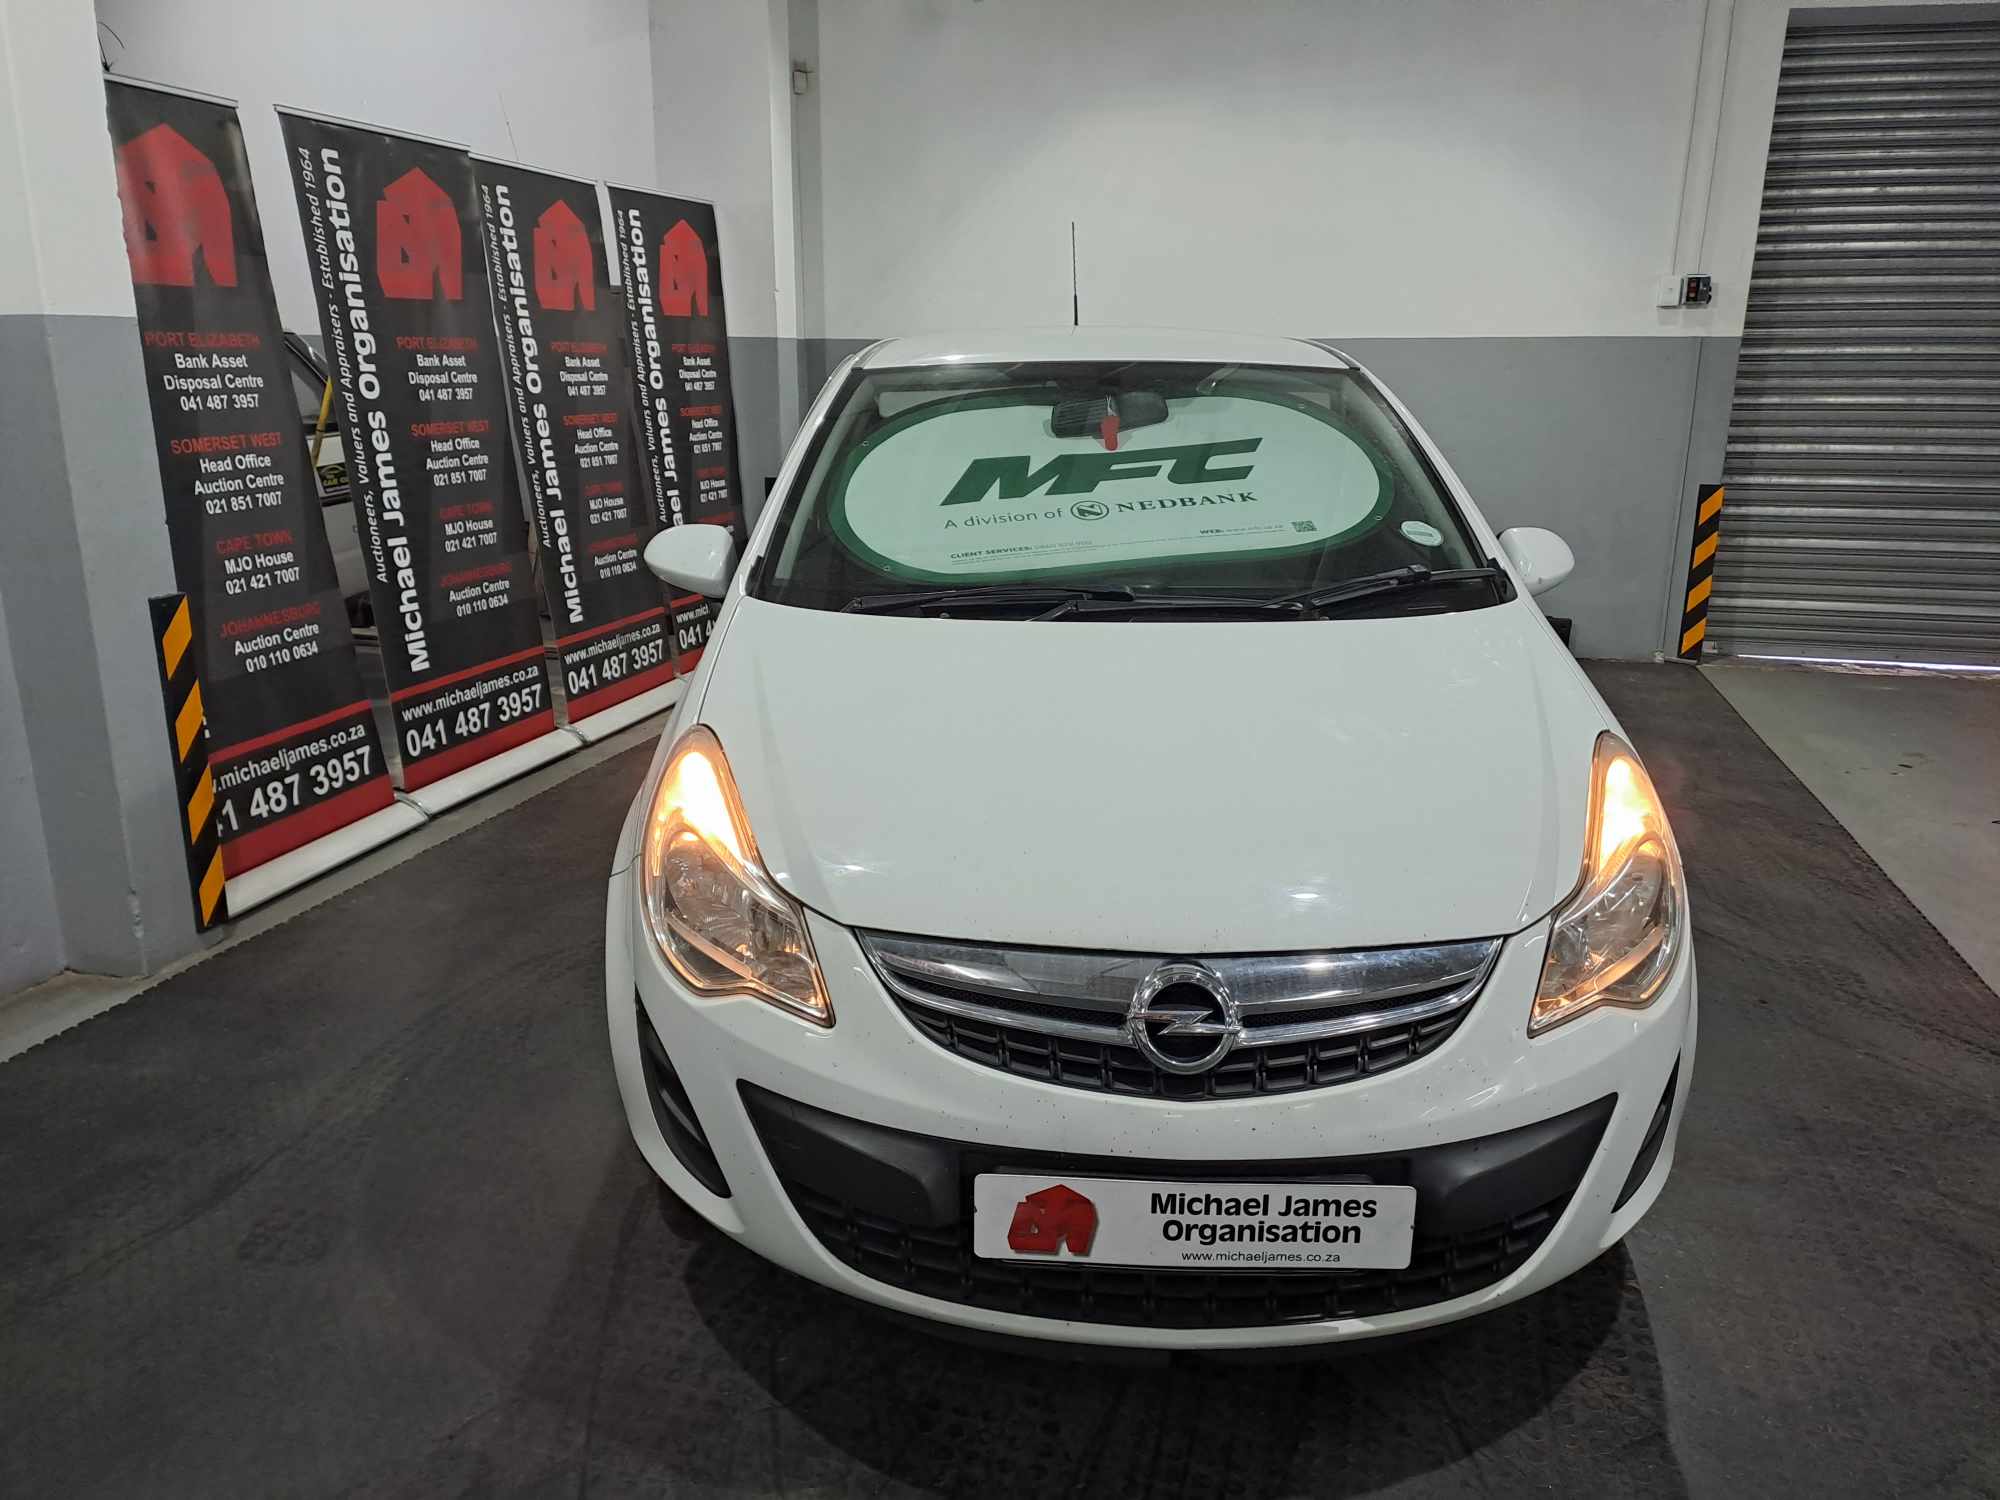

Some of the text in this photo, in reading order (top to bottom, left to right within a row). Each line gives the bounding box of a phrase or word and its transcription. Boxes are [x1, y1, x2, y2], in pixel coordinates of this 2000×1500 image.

[629, 209, 664, 390] Organisation
[144, 331, 184, 347] PORT
[175, 353, 249, 368] Bank Asset
[298, 147, 388, 583] Auctioneers, Valuers and Appraisers Established 1964
[416, 354, 466, 367] Bank Asset
[481, 185, 551, 548] Auctioneers, Valuers and Appraisers Established 1964
[164, 373, 264, 393] Disposal Centre
[408, 371, 478, 387] Disposal Centre
[180, 394, 259, 411] 041 487 3957
[418, 388, 473, 401] 041 487 3957
[496, 185, 583, 623] Michael James Organisation
[321, 148, 430, 672] Michael James Organisation
[171, 432, 282, 454] SOMERSET WEST
[430, 438, 480, 452] Head Office
[575, 443, 598, 454] Auction
[655, 398, 678, 482] James
[200, 454, 271, 473] Head Office
[426, 454, 489, 470] Auction Centre
[939, 437, 1263, 506] MFC
[195, 473, 285, 495] Auction Centre
[433, 469, 487, 486] 021 851 7007
[206, 491, 282, 515] 021 851 7007
[944, 491, 1258, 529] A division of NEDBANK
[444, 519, 493, 535] MJO House
[445, 532, 497, 552] 021 421 7007
[950, 550, 982, 560] CLIENT
[985, 545, 1033, 556] SERVICES:
[224, 551, 294, 574] MJO House
[594, 553, 617, 567] Auction
[225, 567, 300, 595] 021 421 7007
[449, 579, 510, 602] Auction Centre
[456, 593, 509, 617] 010 110 0634
[234, 624, 319, 656] Auction Centre
[564, 623, 661, 665] www.michaeljames.co.za
[679, 624, 702, 649] 041
[245, 640, 318, 673] 010 110 0634
[568, 639, 663, 694] 041 487 3957
[401, 665, 539, 721] www.michaeljames.co.za
[406, 683, 542, 757] 041 487 3957
[250, 773, 300, 818] 487
[310, 745, 370, 795] 3957
[1150, 1192, 1378, 1218] Michael James
[1162, 1219, 1362, 1246] Organisation
[1181, 1250, 1341, 1264] www.michaeljames.co.za
